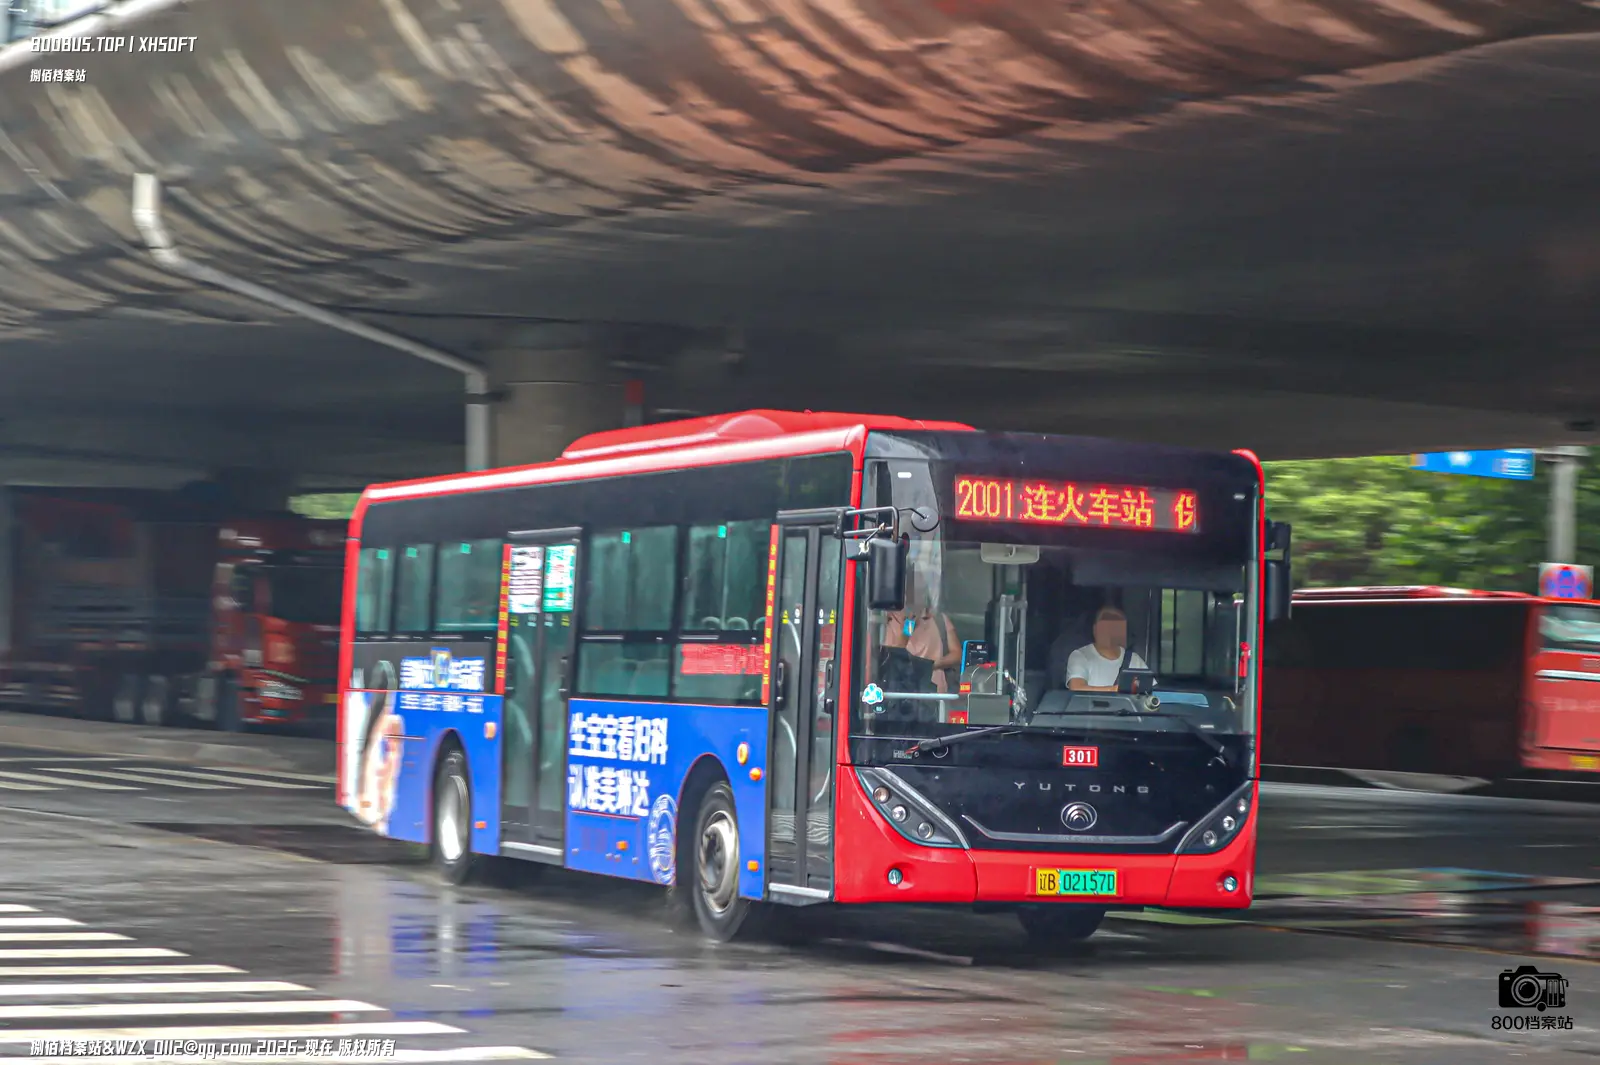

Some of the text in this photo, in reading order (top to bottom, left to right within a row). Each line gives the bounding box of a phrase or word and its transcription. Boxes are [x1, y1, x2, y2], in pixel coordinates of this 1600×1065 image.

[957, 479, 1013, 519] 2001
[1068, 750, 1091, 763] 301
[1014, 782, 1149, 793] YUTONG
